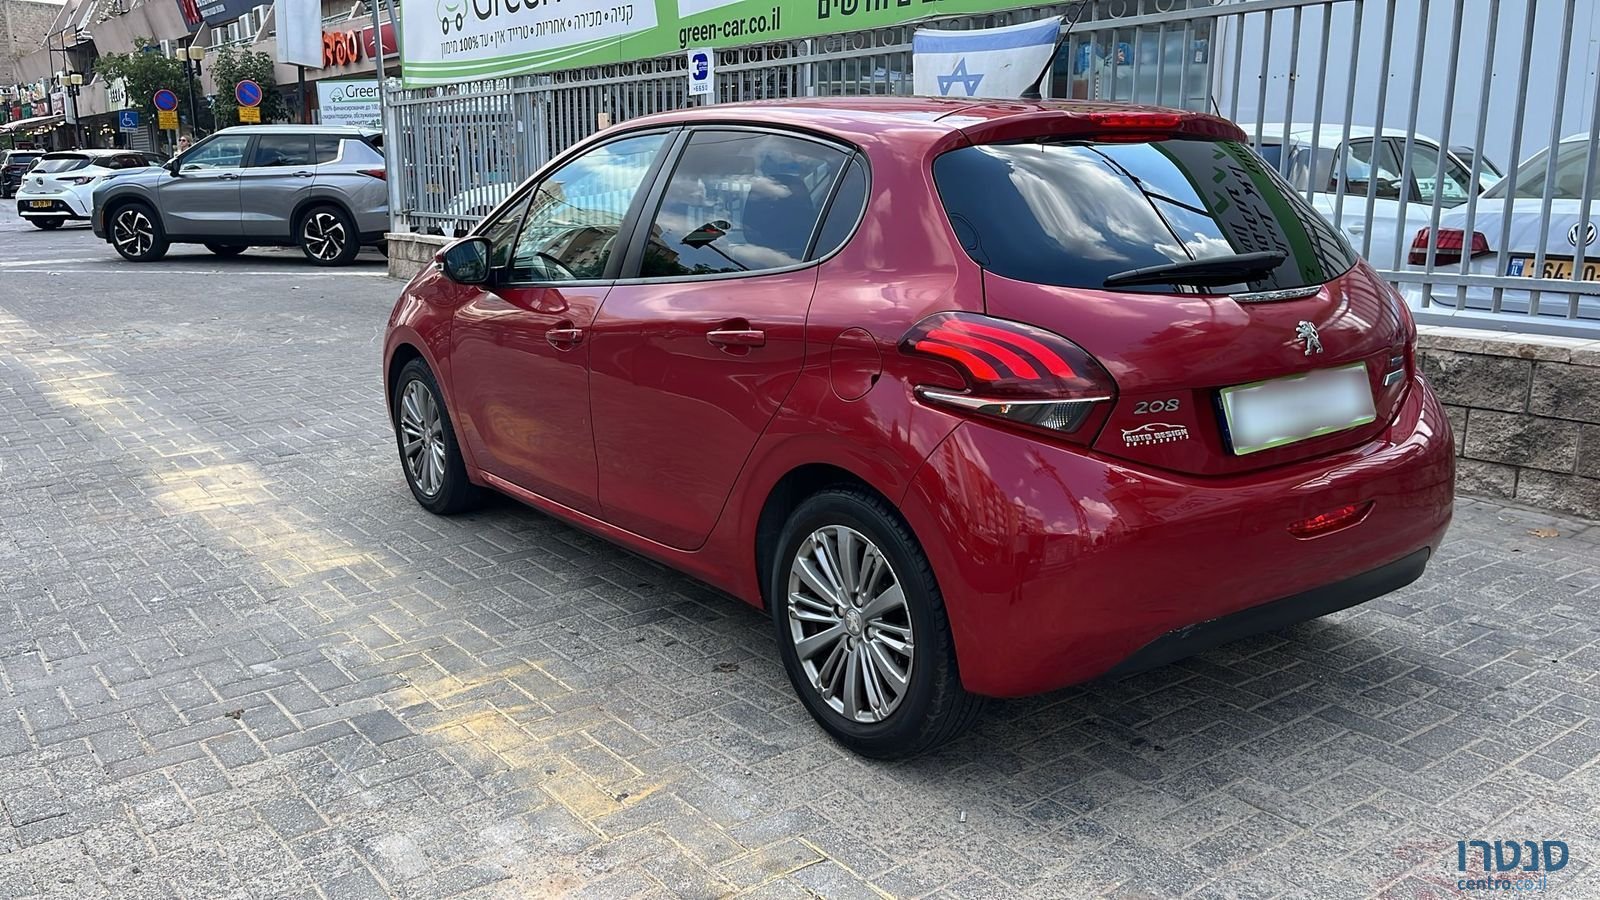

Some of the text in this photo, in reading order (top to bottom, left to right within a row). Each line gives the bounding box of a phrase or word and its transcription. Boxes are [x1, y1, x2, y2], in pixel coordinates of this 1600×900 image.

[574, 10, 602, 30] מכירה
[611, 5, 633, 25] קניה
[507, 25, 529, 42] טרייד
[536, 17, 566, 37] אחריות
[679, 6, 781, 49] green-car.co.il
[460, 35, 479, 52] 100%
[480, 33, 489, 47] עד
[494, 29, 506, 49] אין
[440, 40, 458, 60] מימון
[1133, 398, 1180, 415] 208
[1126, 433, 1153, 443] AUTO
[1153, 428, 1188, 440] DESIGN
